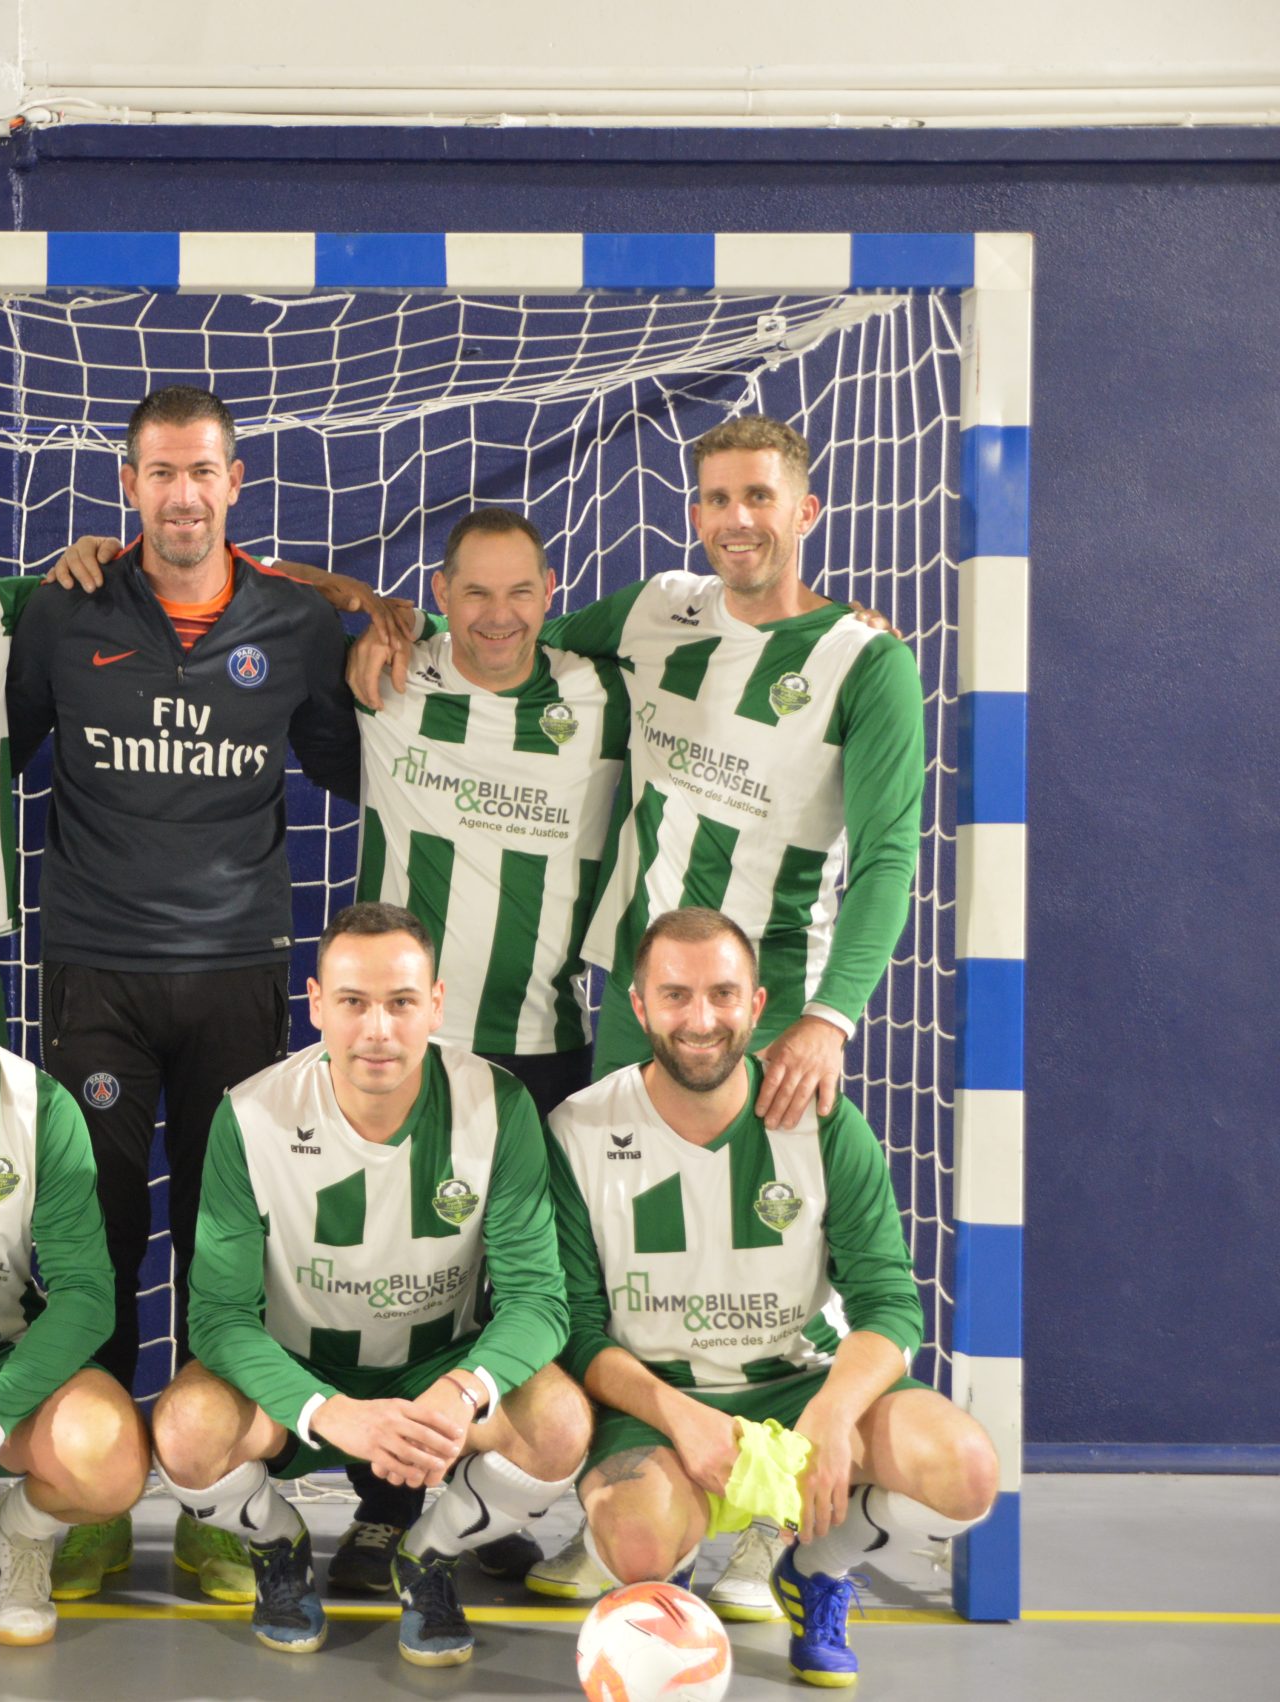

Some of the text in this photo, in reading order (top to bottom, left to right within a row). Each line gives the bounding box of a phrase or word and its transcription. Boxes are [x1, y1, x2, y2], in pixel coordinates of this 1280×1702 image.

[236, 648, 260, 660] PARIS
[152, 697, 211, 735] Fly
[84, 727, 268, 777] Emirates
[704, 788, 722, 802] des
[723, 796, 768, 818] Justices
[459, 816, 569, 840] Agence des Justices
[88, 1074, 112, 1084] PARIS
[290, 1143, 321, 1155] erima
[607, 1149, 642, 1160] erima
[373, 1300, 442, 1320] Agence des
[691, 1337, 737, 1350] Agence
[741, 1335, 763, 1346] des
